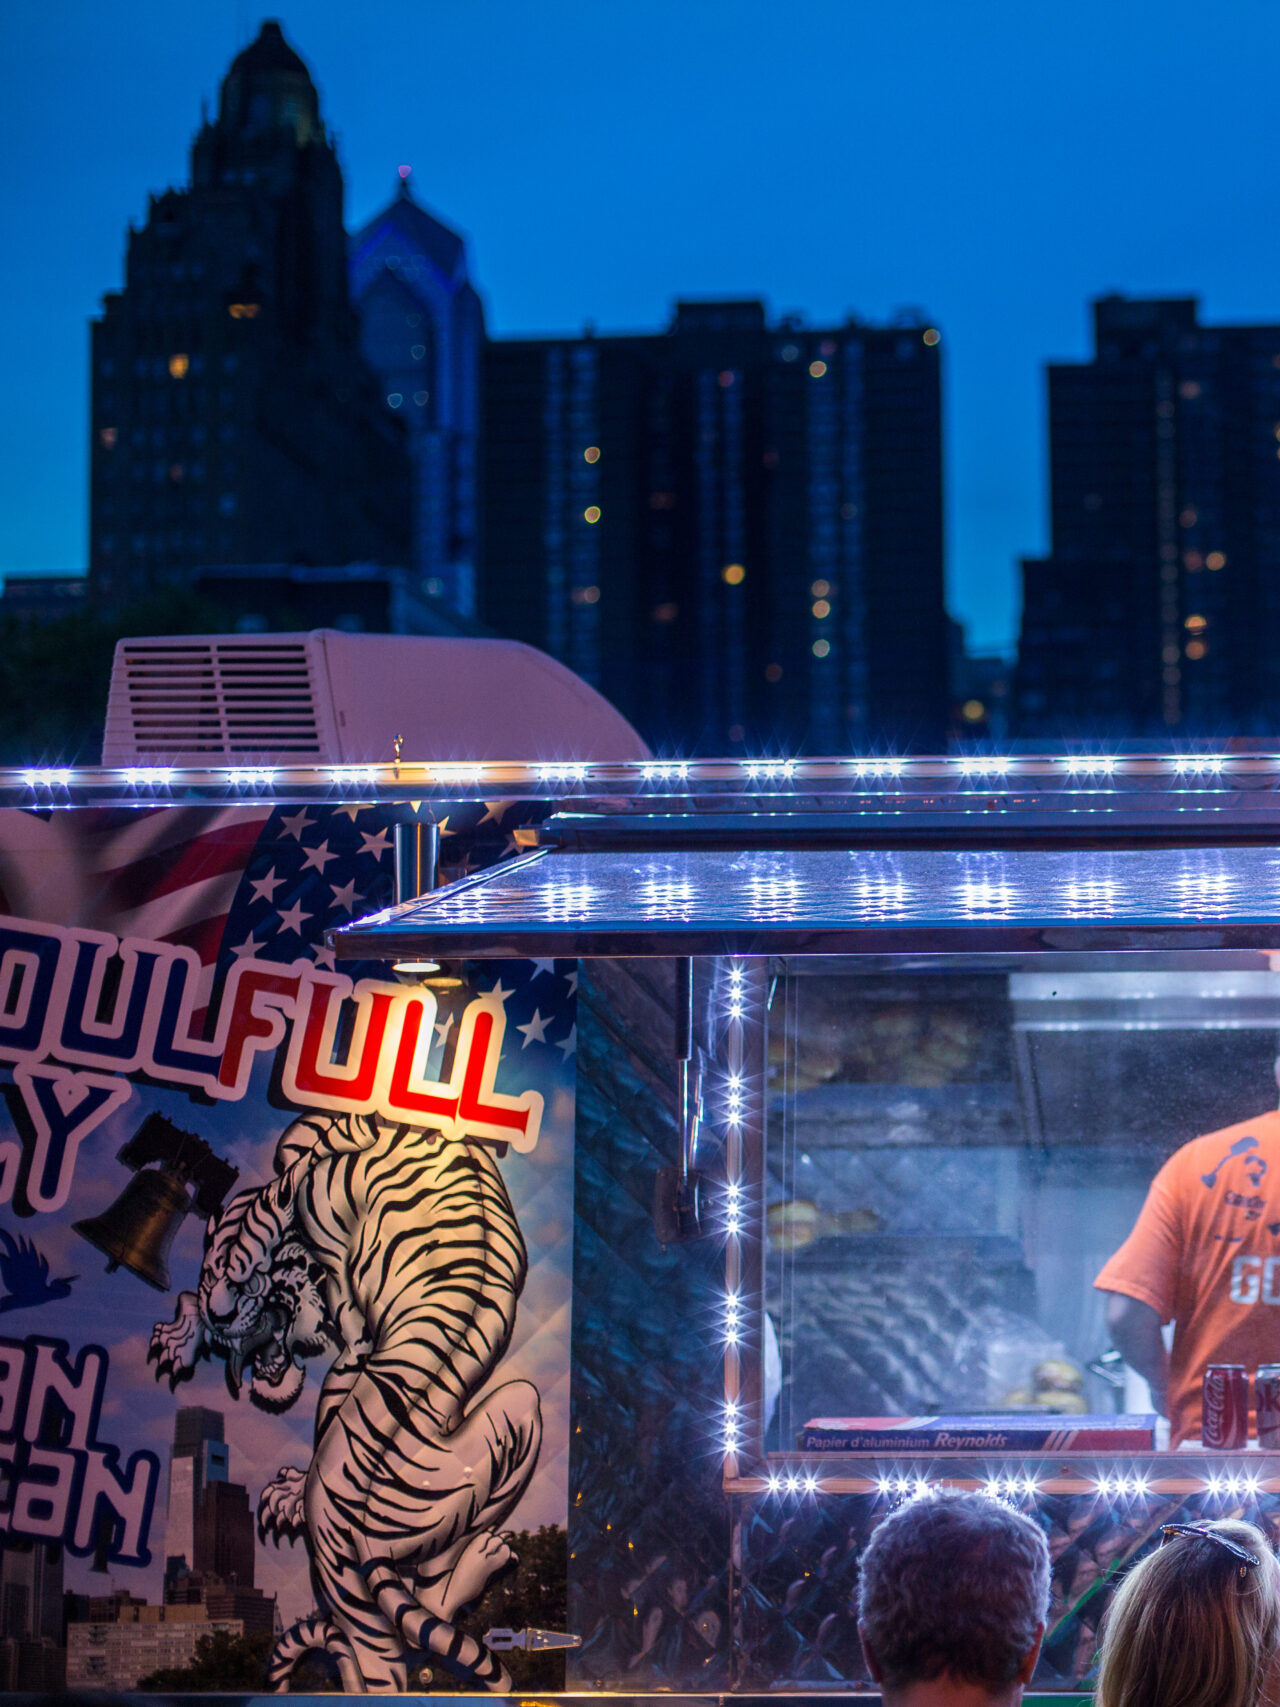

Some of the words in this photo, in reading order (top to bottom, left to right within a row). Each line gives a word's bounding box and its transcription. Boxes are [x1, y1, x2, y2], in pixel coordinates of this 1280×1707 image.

[806, 1435, 849, 1450] Papier
[850, 1436, 931, 1449] d'aluminium
[933, 1431, 1009, 1451] Reynolds
